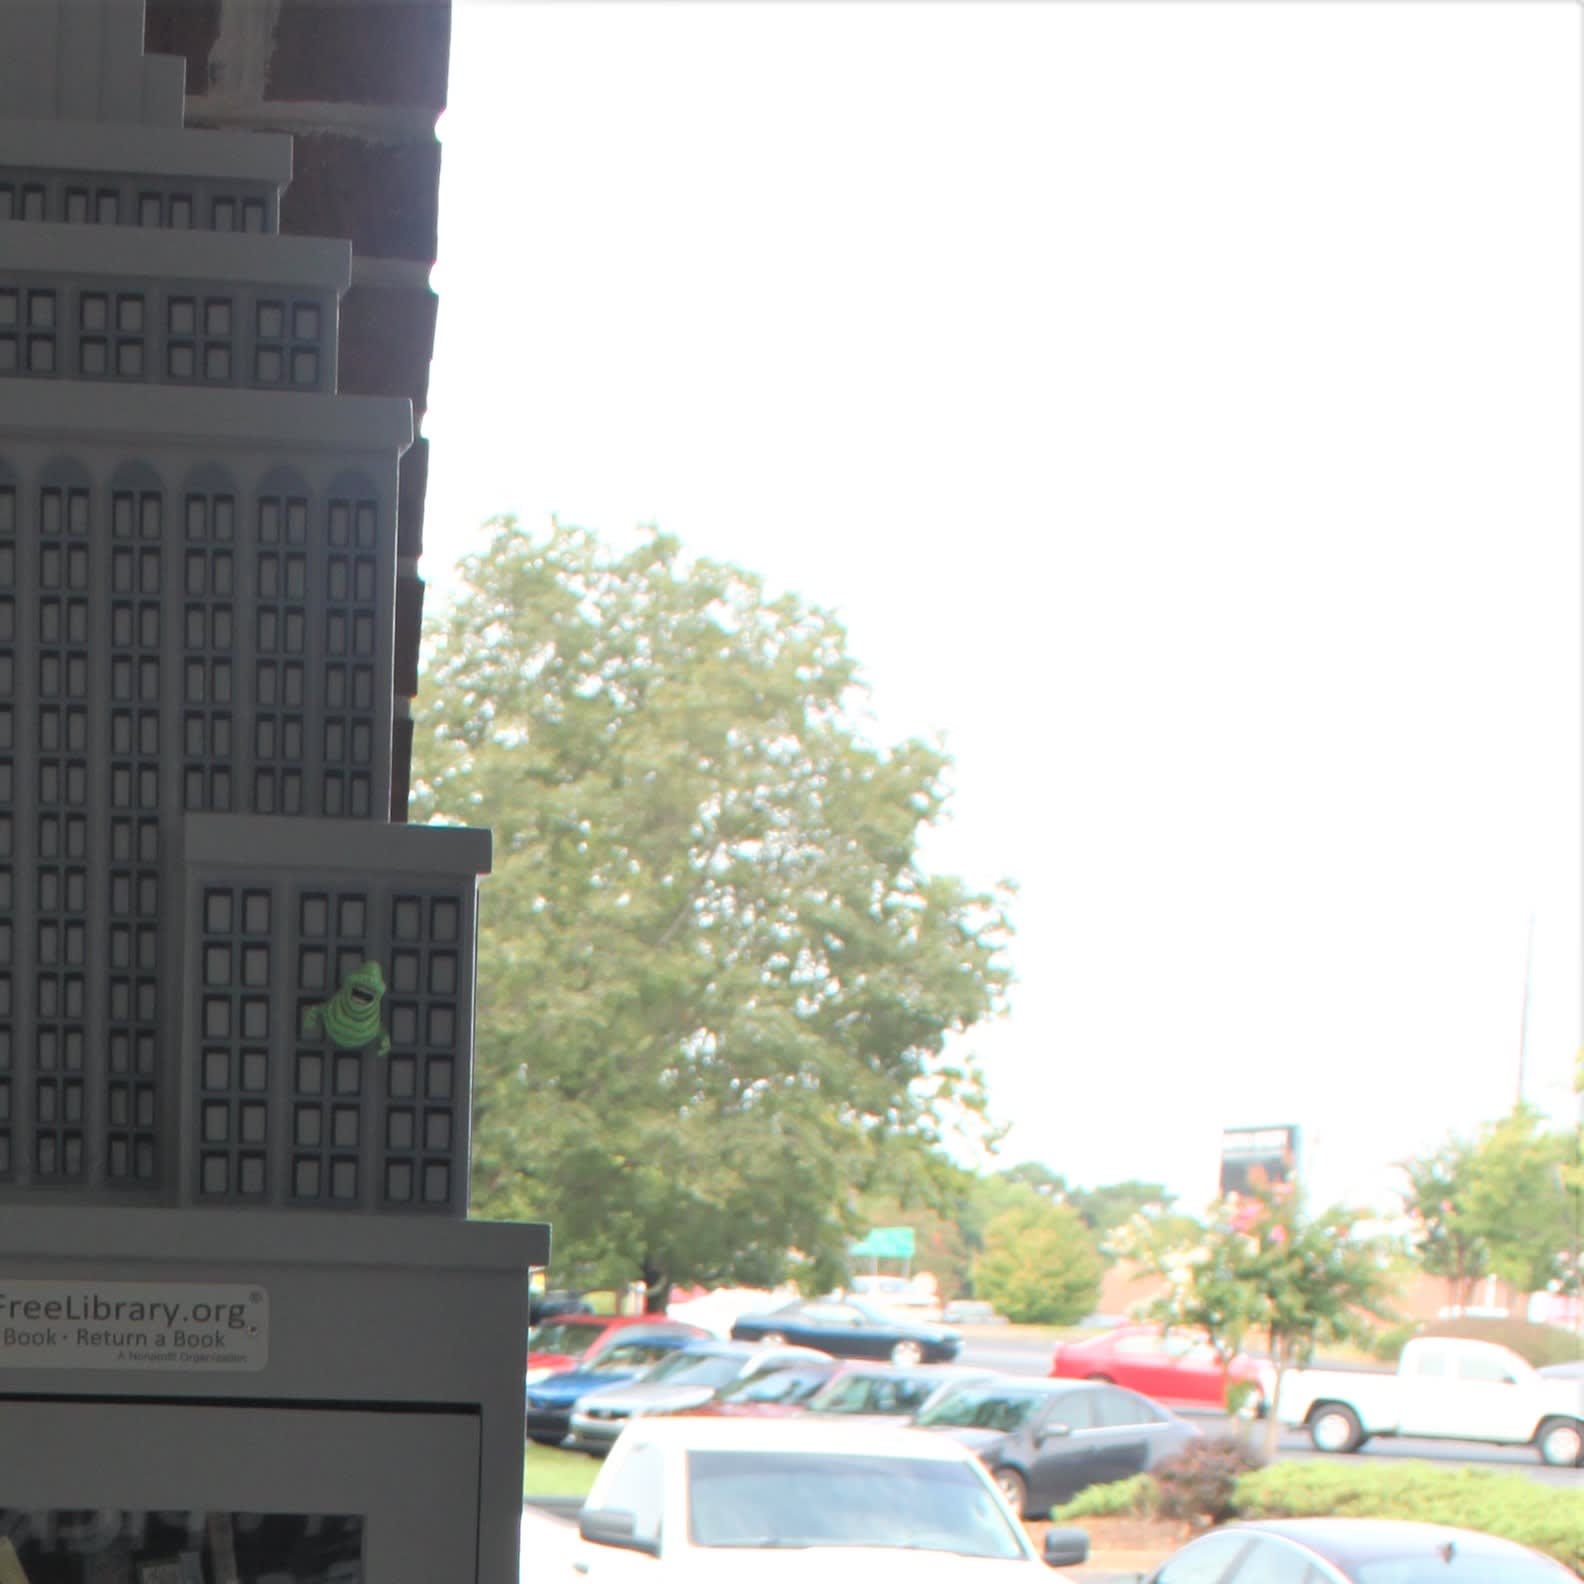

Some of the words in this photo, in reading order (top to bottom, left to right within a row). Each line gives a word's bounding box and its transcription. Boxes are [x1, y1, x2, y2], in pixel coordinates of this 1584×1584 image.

[3, 1327, 57, 1346] Book
[76, 1328, 148, 1347] Return
[154, 1332, 167, 1348] a
[173, 1329, 226, 1348] Book
